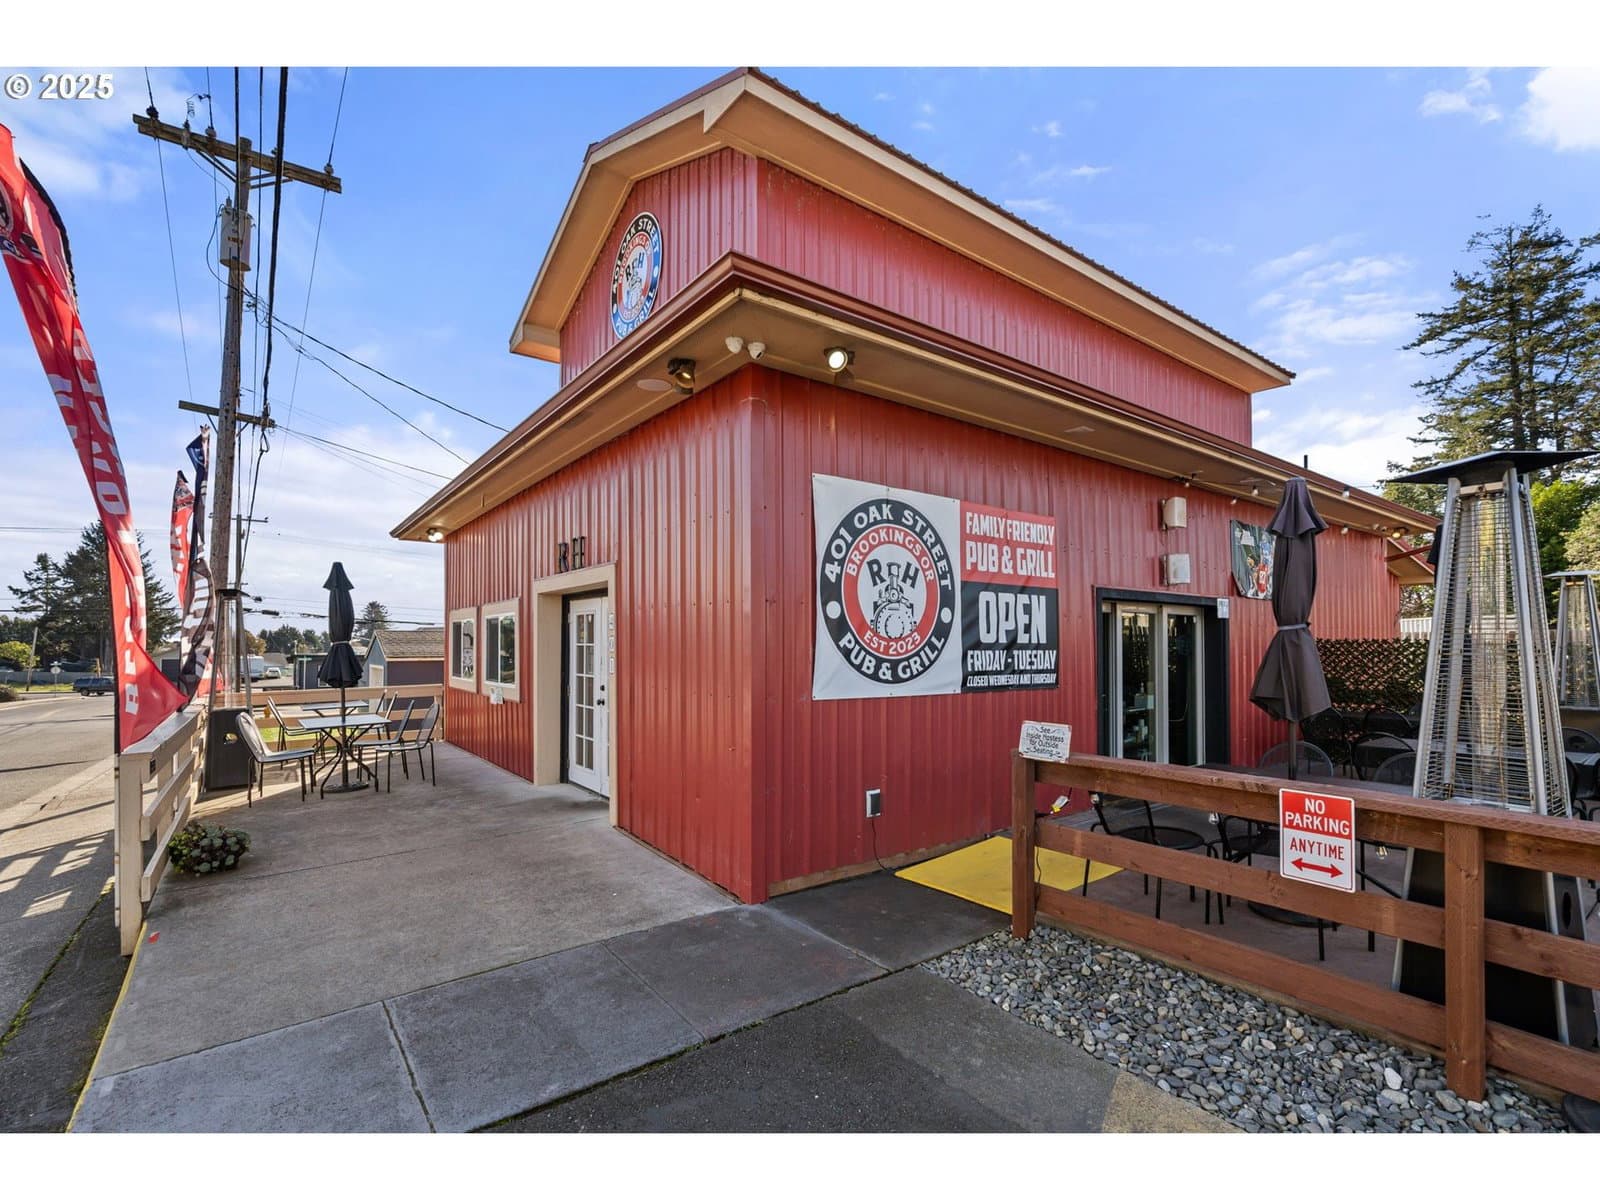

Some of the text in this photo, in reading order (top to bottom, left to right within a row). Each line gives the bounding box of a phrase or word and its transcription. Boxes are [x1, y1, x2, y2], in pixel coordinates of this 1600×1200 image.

[638, 218, 659, 253] STREET
[966, 511, 1055, 546] FAMILY FRIENDLY
[825, 504, 951, 590] 401 OAK STREET
[847, 529, 935, 582] BROOKINGS OR
[966, 540, 1055, 578] PUB & GRILL
[979, 591, 1047, 644] OPEN
[839, 632, 945, 680] PUB & GRILL
[864, 630, 921, 655] EST 2023
[967, 650, 1007, 671] FRIDAY
[1013, 650, 1056, 670] TUESDAY
[967, 673, 1056, 687] CLOSED WEDNESDAY AND THURSDAY
[1285, 811, 1350, 835] PARKING
[1305, 797, 1325, 815] NO
[1290, 837, 1345, 861] ANYTIME
